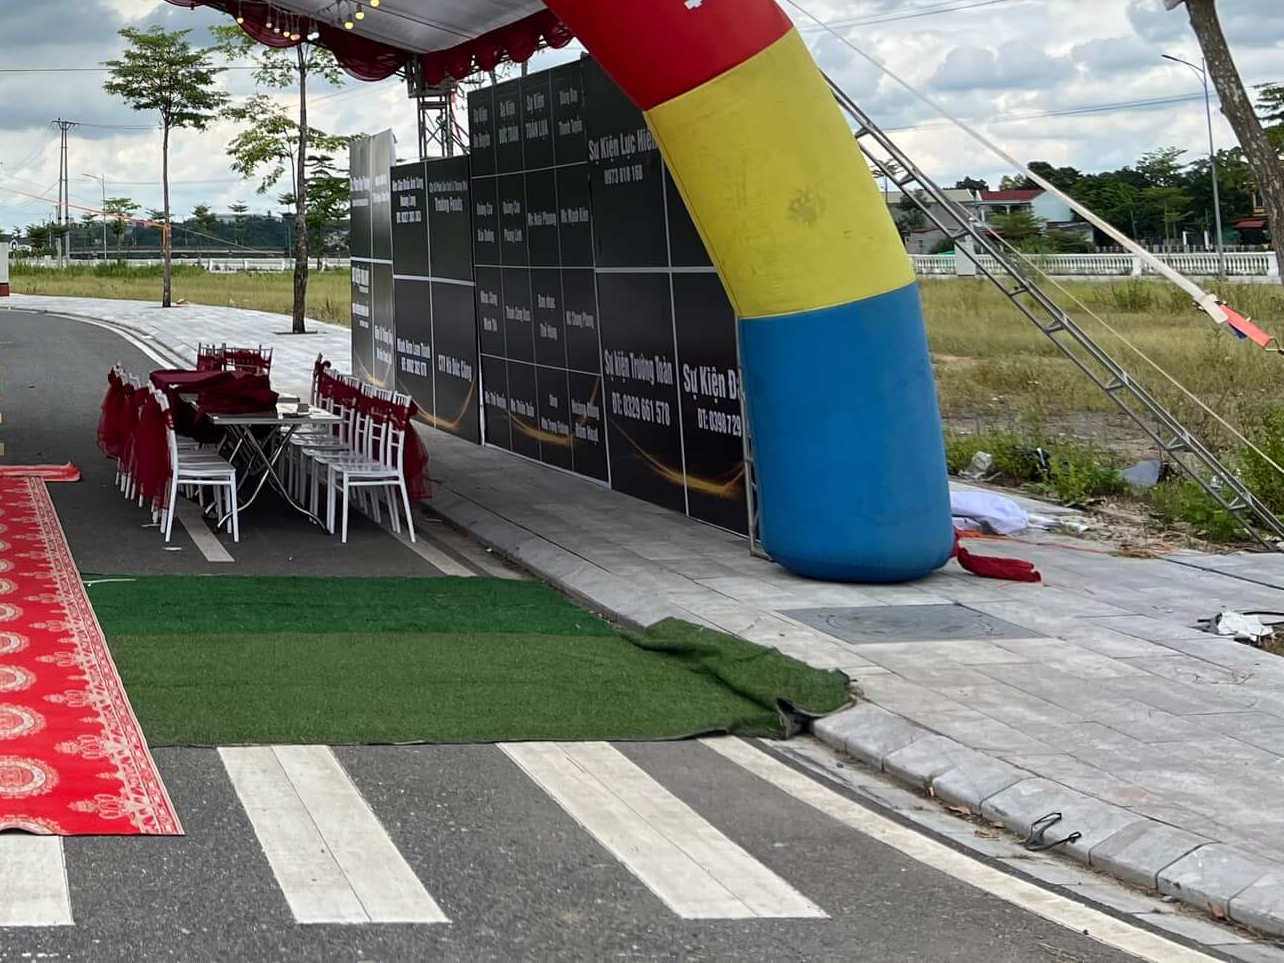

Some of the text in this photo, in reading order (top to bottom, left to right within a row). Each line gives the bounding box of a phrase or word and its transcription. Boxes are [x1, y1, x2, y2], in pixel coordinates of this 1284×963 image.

[589, 139, 600, 165] Sự
[600, 135, 620, 162] Kiện
[620, 133, 636, 160] Lực
[604, 349, 614, 381] Sự
[683, 363, 698, 401] Sự
[699, 365, 726, 404] Kiện
[623, 394, 641, 420] 0329
[641, 397, 655, 423] 661
[656, 400, 671, 427] 578
